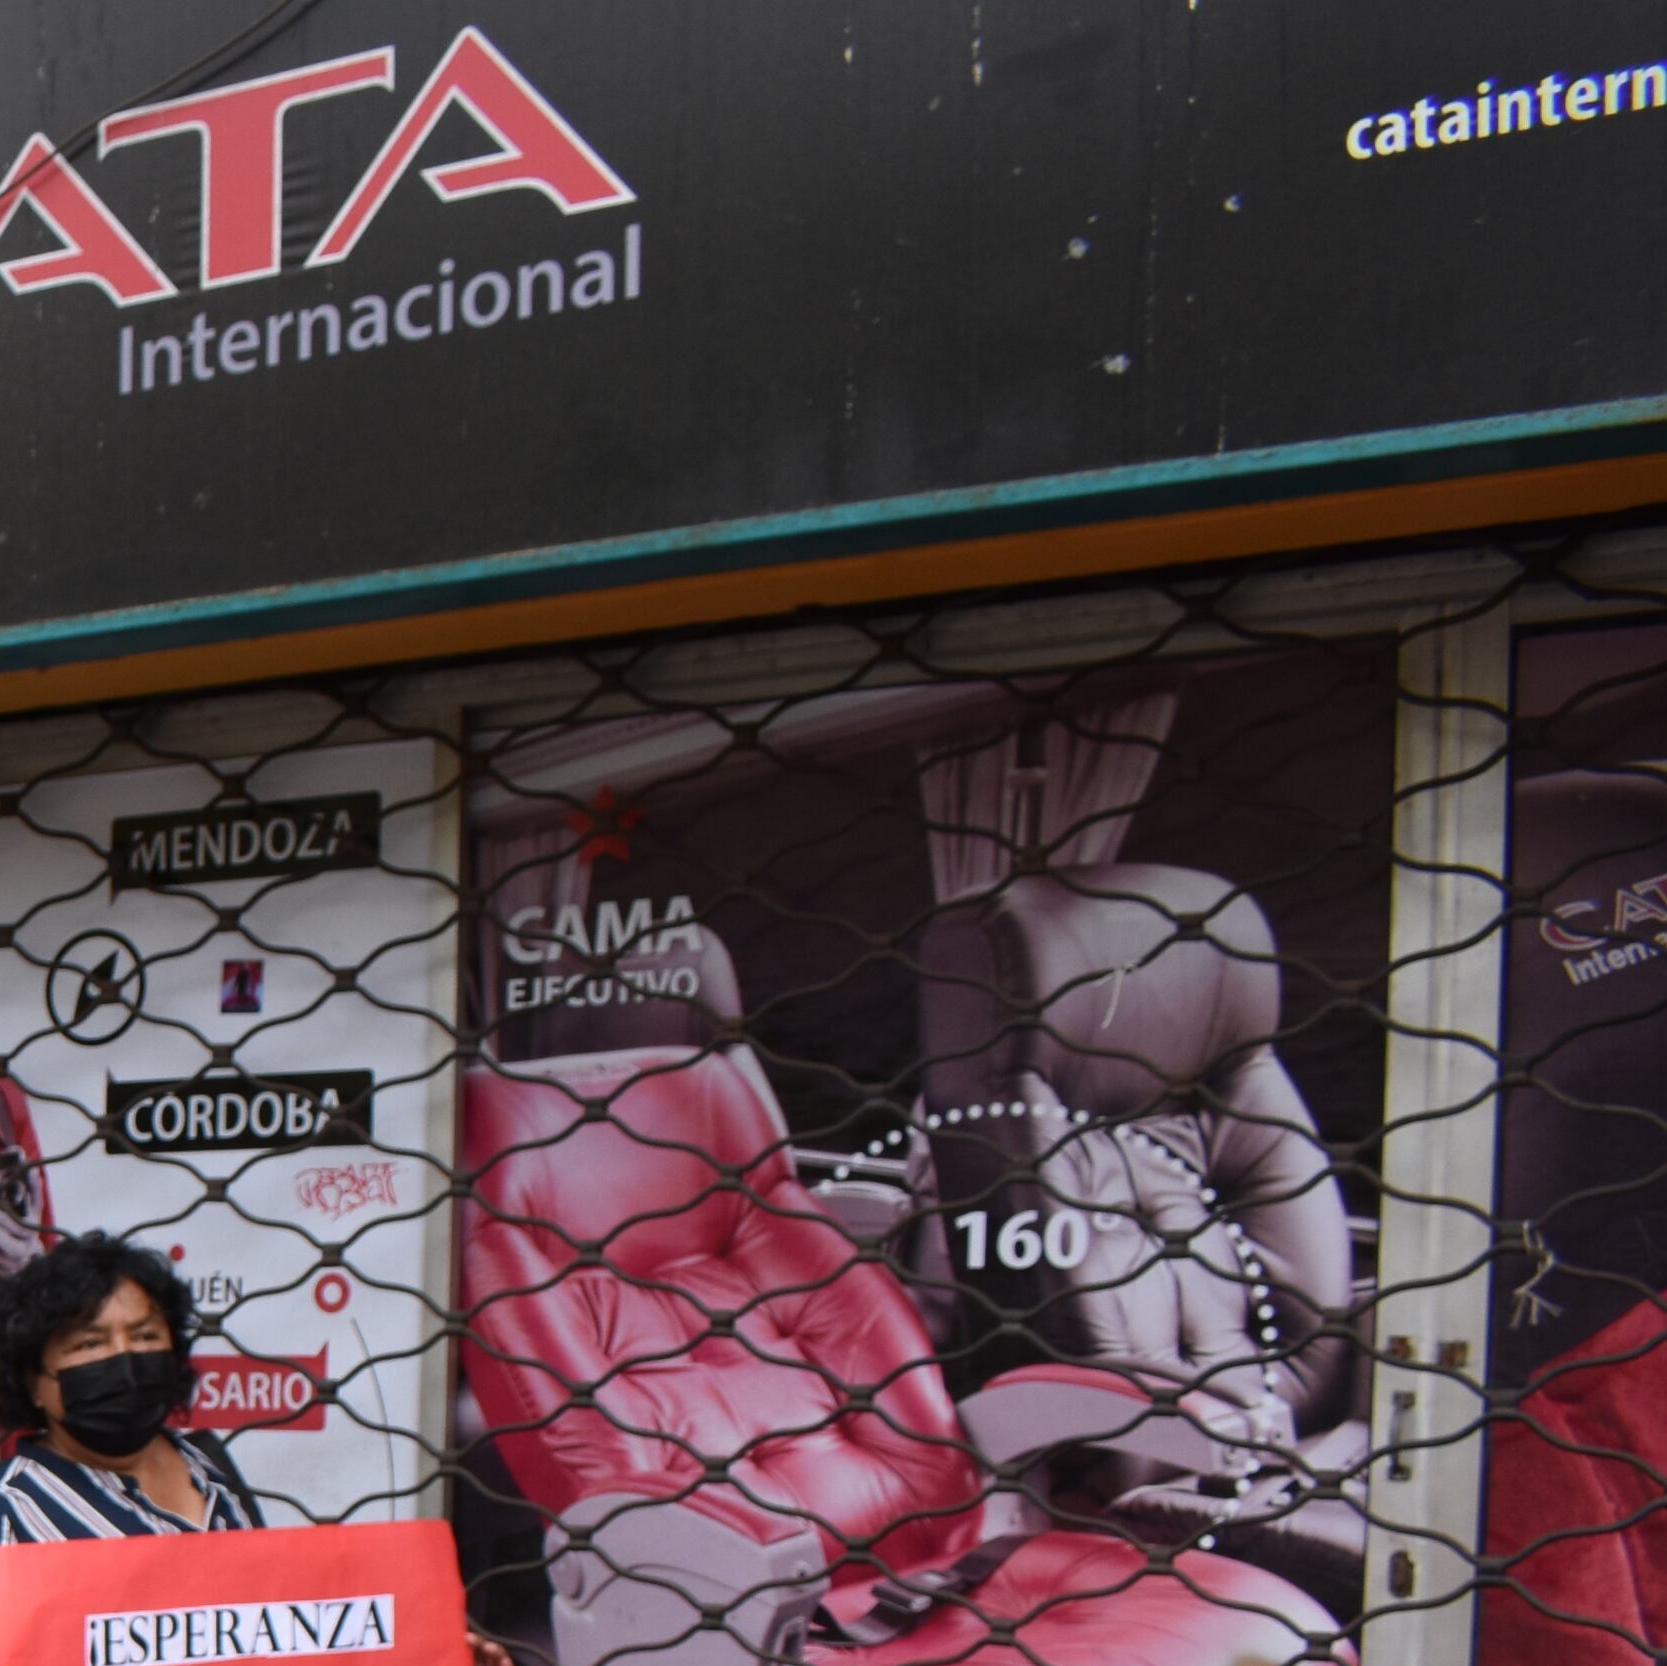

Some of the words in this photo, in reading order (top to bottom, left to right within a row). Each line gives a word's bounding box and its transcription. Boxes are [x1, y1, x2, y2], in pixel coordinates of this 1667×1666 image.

[118, 223, 642, 395] Internacional
[129, 808, 353, 874] MENDOZA
[503, 895, 704, 966] CAMA
